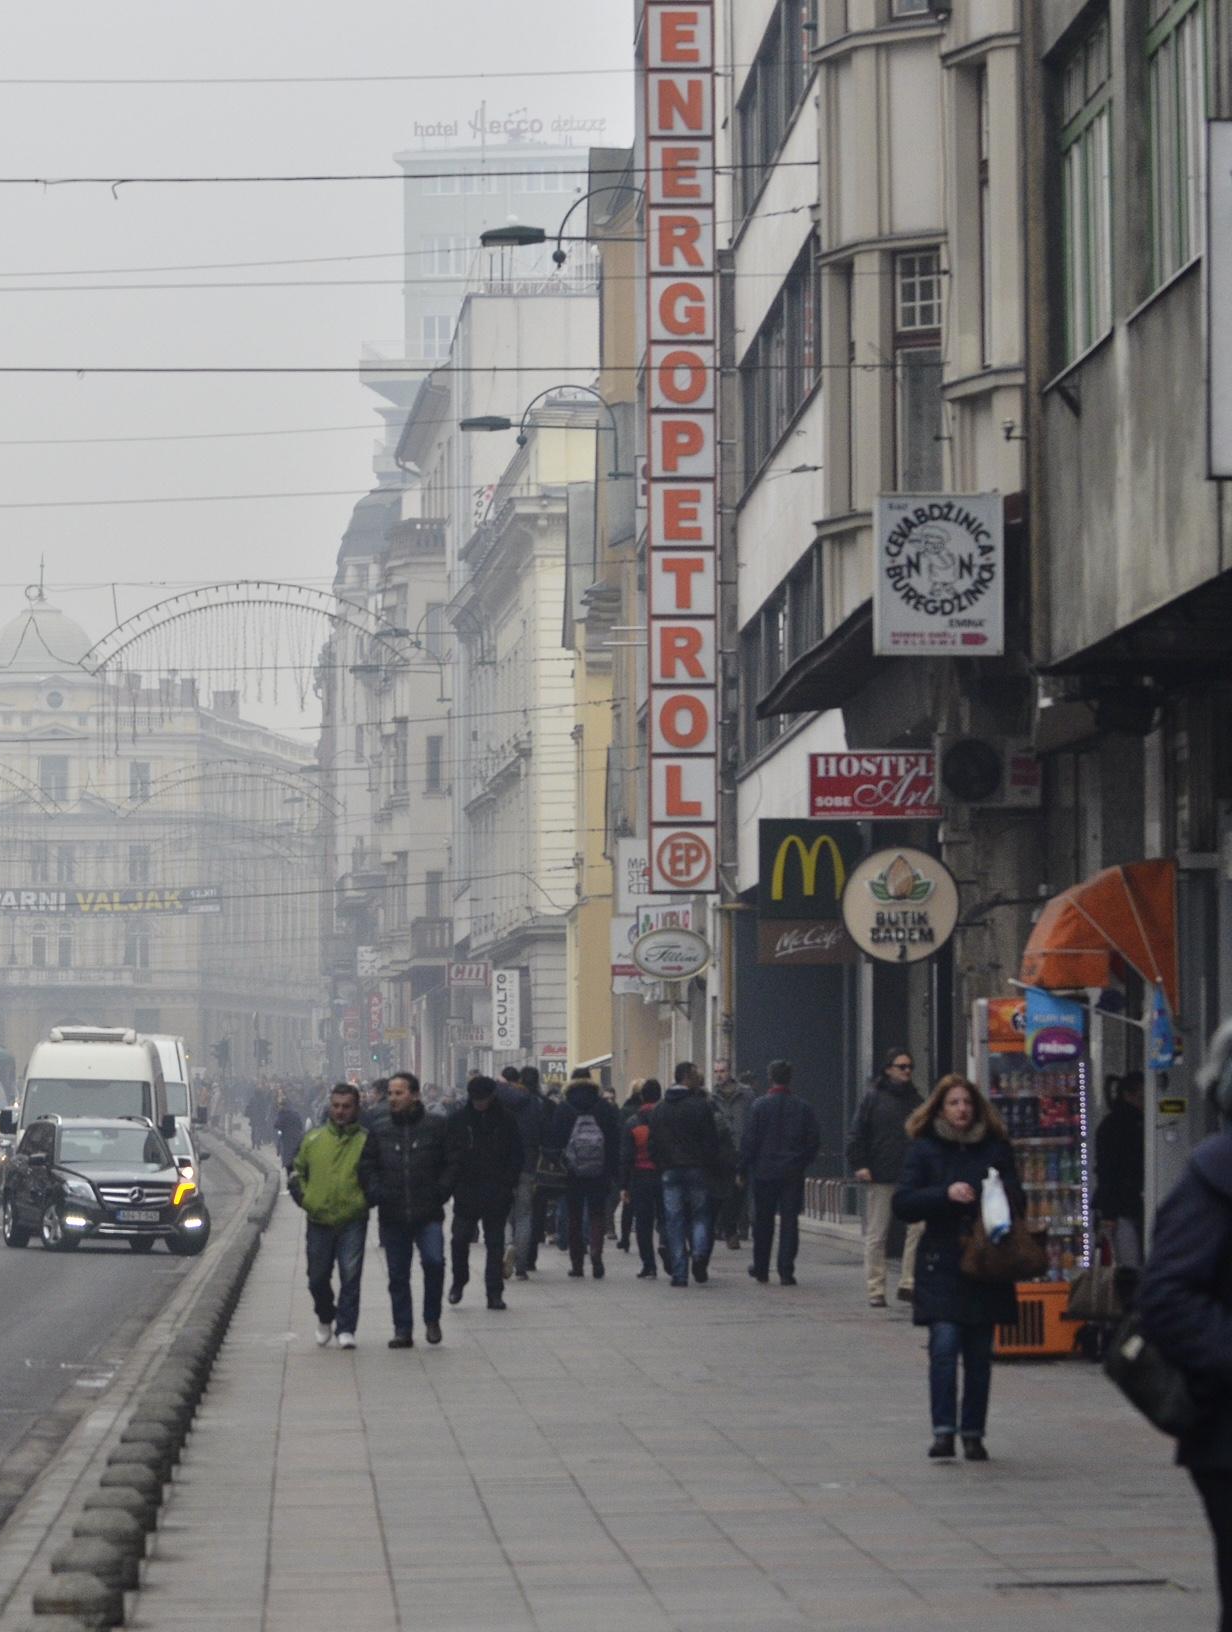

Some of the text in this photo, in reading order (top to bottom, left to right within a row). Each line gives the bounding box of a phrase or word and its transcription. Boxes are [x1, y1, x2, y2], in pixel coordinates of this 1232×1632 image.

[414, 120, 458, 136] hotel
[658, 11, 708, 816] ENERGOPETROL
[817, 756, 934, 777] HOSTEL
[815, 795, 853, 807] SOBE
[76, 890, 183, 913] VALJAK
[876, 911, 929, 925] BUTIK
[871, 928, 935, 942] BADEM
[497, 973, 507, 1037] OCULTO
